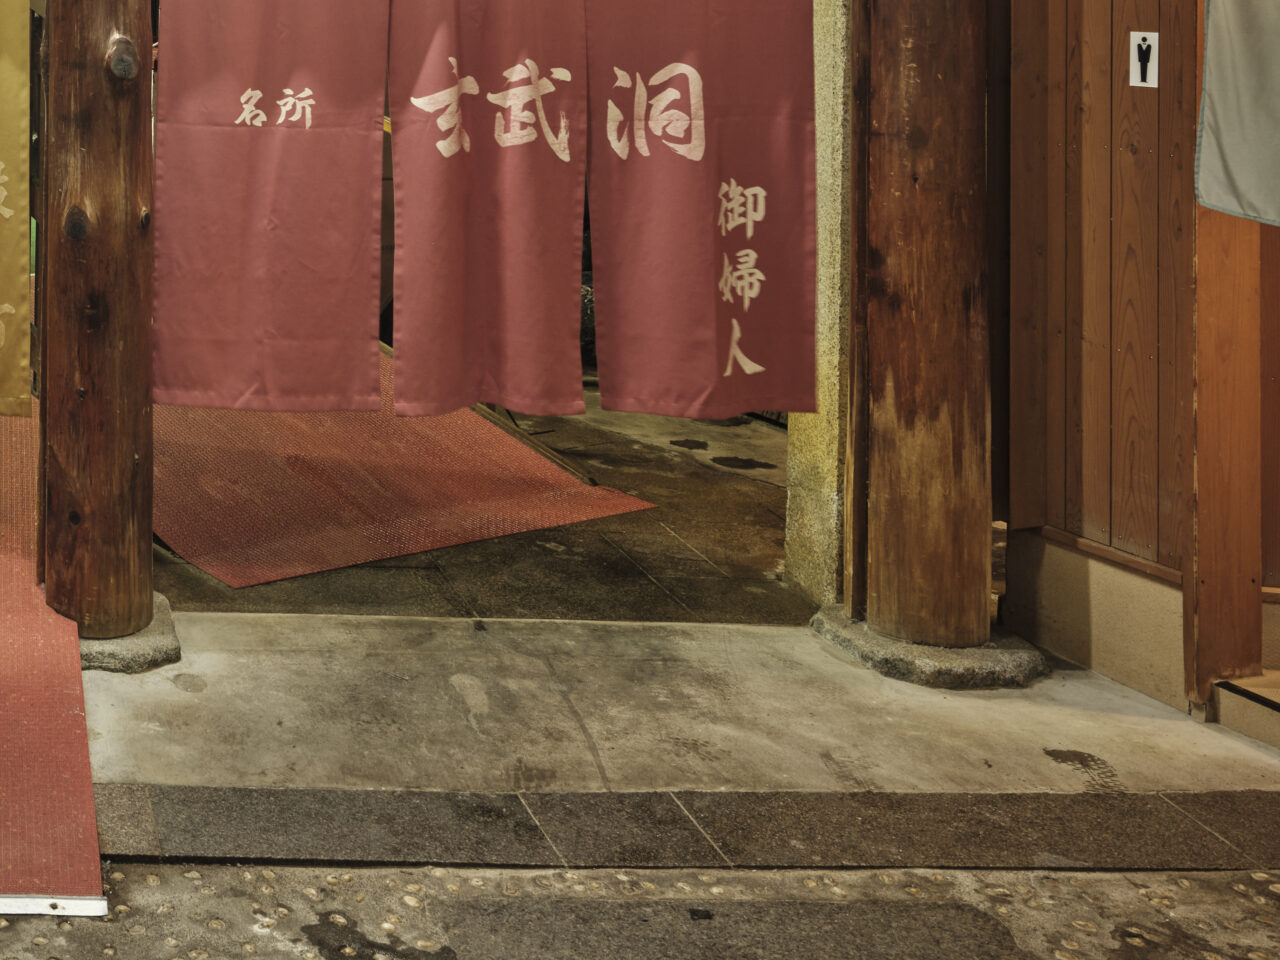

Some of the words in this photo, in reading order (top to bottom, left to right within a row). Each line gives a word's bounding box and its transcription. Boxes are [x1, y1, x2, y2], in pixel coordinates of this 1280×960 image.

[234, 87, 316, 130] 名所
[410, 56, 706, 162] 玄武洞
[717, 177, 767, 378] 御婦人
